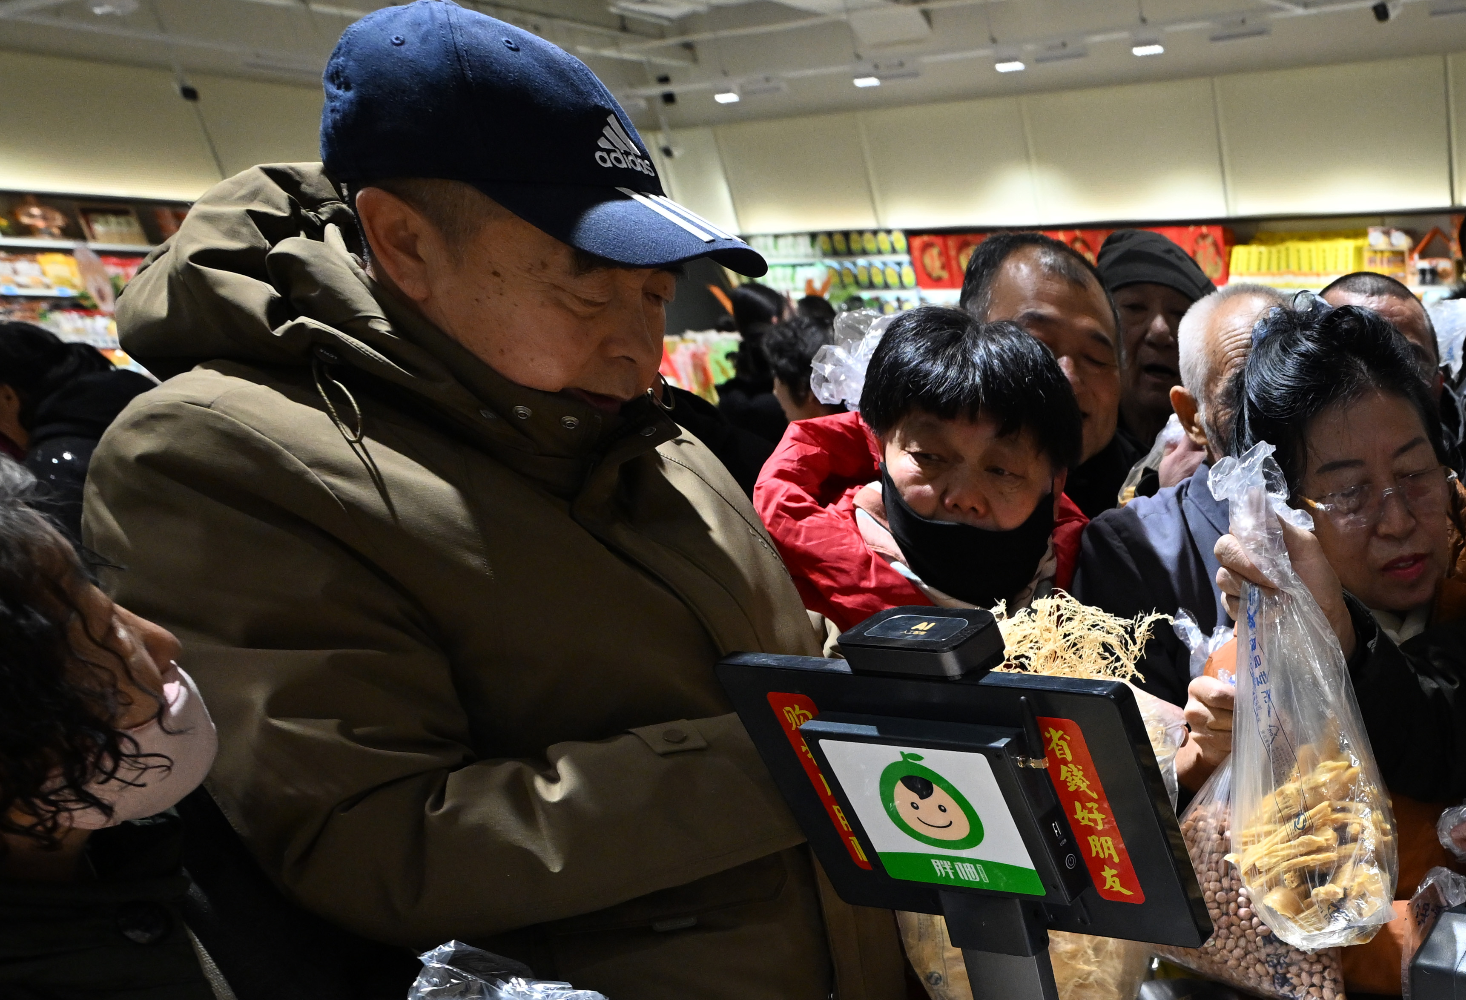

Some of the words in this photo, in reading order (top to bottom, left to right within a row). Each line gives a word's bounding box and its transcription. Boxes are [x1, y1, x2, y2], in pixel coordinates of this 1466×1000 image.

[594, 147, 655, 176] adidas
[910, 621, 936, 631] AI
[930, 859, 980, 882] 胖柚
